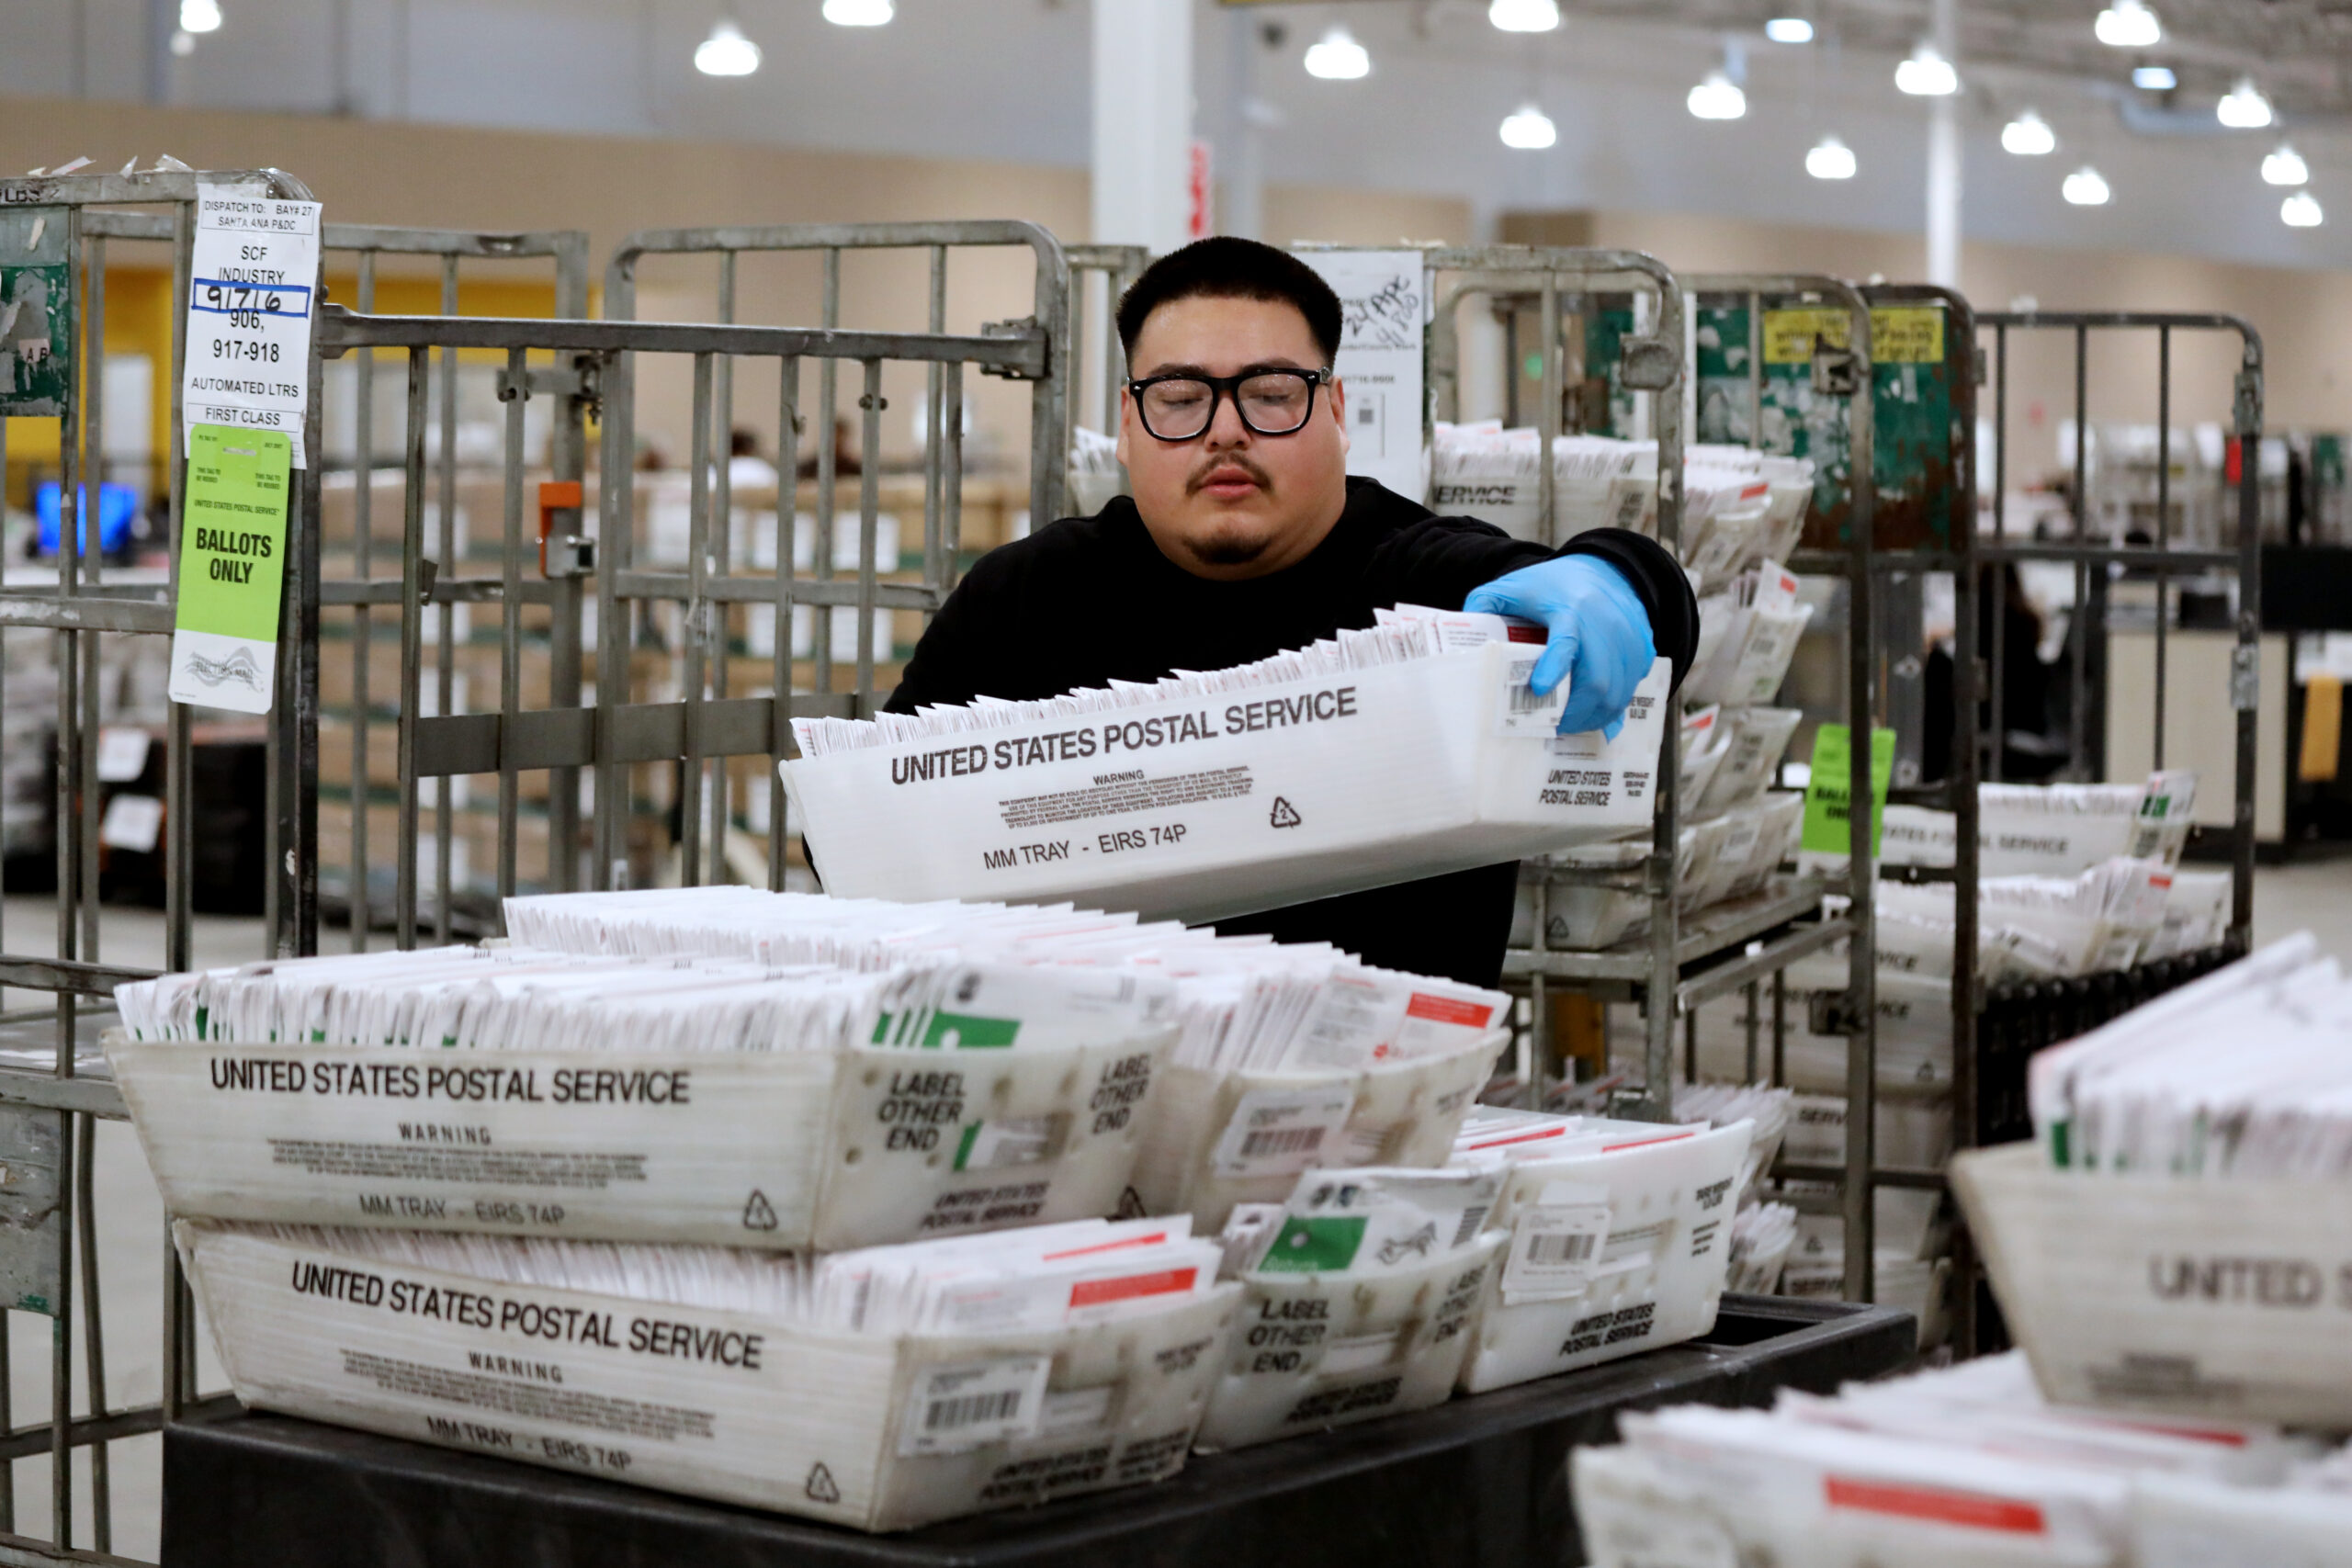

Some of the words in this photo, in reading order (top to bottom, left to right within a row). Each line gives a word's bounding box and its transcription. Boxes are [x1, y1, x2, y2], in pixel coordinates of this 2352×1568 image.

[205, 200, 249, 213] DISPATCH
[251, 203, 266, 213] TO:
[276, 204, 299, 215] BAY#
[301, 206, 312, 216] 27
[218, 216, 248, 227] SANTA
[251, 219, 269, 229] ANA
[271, 220, 296, 231] P&DC
[241, 245, 268, 261] SCF
[219, 266, 286, 286] INDUSTRY
[230, 309, 265, 333] 906,
[213, 338, 280, 363] 917-918
[191, 377, 266, 395] AUTOMATED
[268, 383, 300, 398] LTRS
[205, 407, 239, 423] FIRST
[241, 410, 281, 425] CLASS
[194, 499, 212, 508] UNITED
[213, 501, 232, 511] STATES
[233, 503, 254, 513] POSTAL
[1434, 485, 1517, 506] ERVICE
[196, 526, 273, 558] BALLOTS
[209, 558, 254, 585] ONLY
[891, 743, 988, 786] UNITED
[994, 727, 1098, 770] STATES
[1103, 713, 1219, 755] POSTAL
[1225, 686, 1358, 735] SERVICE
[1092, 770, 1145, 786] WARNING
[1547, 769, 1581, 785] UNITED
[1581, 771, 1611, 787] STATES
[1539, 789, 1573, 805] POSTAL
[1574, 791, 1611, 807] SERVICE
[983, 848, 1015, 871] MM
[1020, 840, 1070, 865] TRAY
[1101, 829, 1147, 854] EIRS
[1150, 823, 1188, 848] 74P
[210, 1057, 306, 1093] UNITED
[312, 1062, 421, 1099] STATES
[426, 1067, 545, 1102] POSTAL
[552, 1070, 691, 1103] SERVICE
[888, 1070, 967, 1098] LABEL
[878, 1100, 964, 1125] OTHER
[1091, 1107, 1132, 1134] END
[399, 1122, 493, 1145] WARNING
[885, 1126, 940, 1152] END
[359, 1195, 394, 1217] MM
[397, 1197, 447, 1221] TRAY
[474, 1201, 525, 1224] EIRS
[528, 1204, 566, 1227] 74P
[292, 1259, 385, 1308] UNITED
[389, 1278, 493, 1330] STATES
[501, 1299, 620, 1350] POSTAL
[629, 1318, 764, 1370] SERVICE
[1260, 1297, 1330, 1321] LABEL
[468, 1350, 565, 1383] WARNING
[1252, 1350, 1303, 1374] END
[425, 1416, 459, 1440] MM
[462, 1424, 514, 1450] TRAY
[543, 1436, 591, 1466] EIRS
[593, 1443, 632, 1471] 74P
